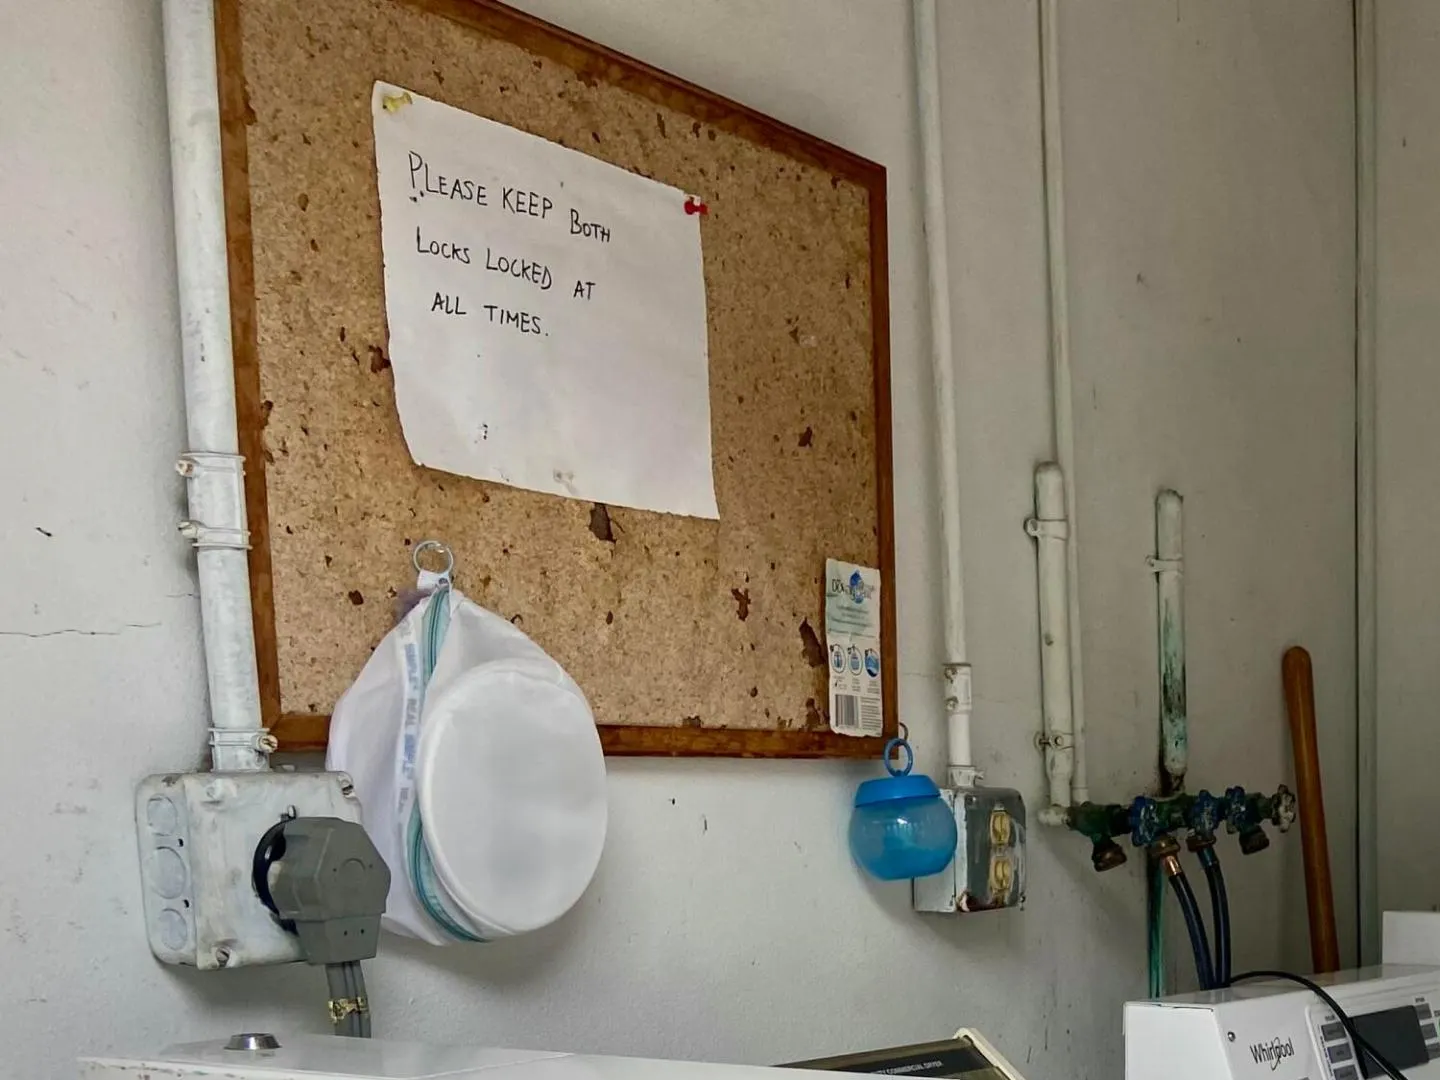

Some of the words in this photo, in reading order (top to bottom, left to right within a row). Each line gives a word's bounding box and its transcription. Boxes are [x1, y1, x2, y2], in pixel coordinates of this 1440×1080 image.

[408, 151, 488, 207] PLEASE
[502, 186, 553, 219] KEEP
[569, 208, 611, 243] BOTH
[416, 226, 470, 265] LOCKS
[486, 248, 552, 290] LOCKED
[573, 281, 596, 300] AT
[431, 292, 467, 315] ALL
[483, 305, 549, 336] TIMES.
[1249, 1037, 1295, 1069] Whirlpool
